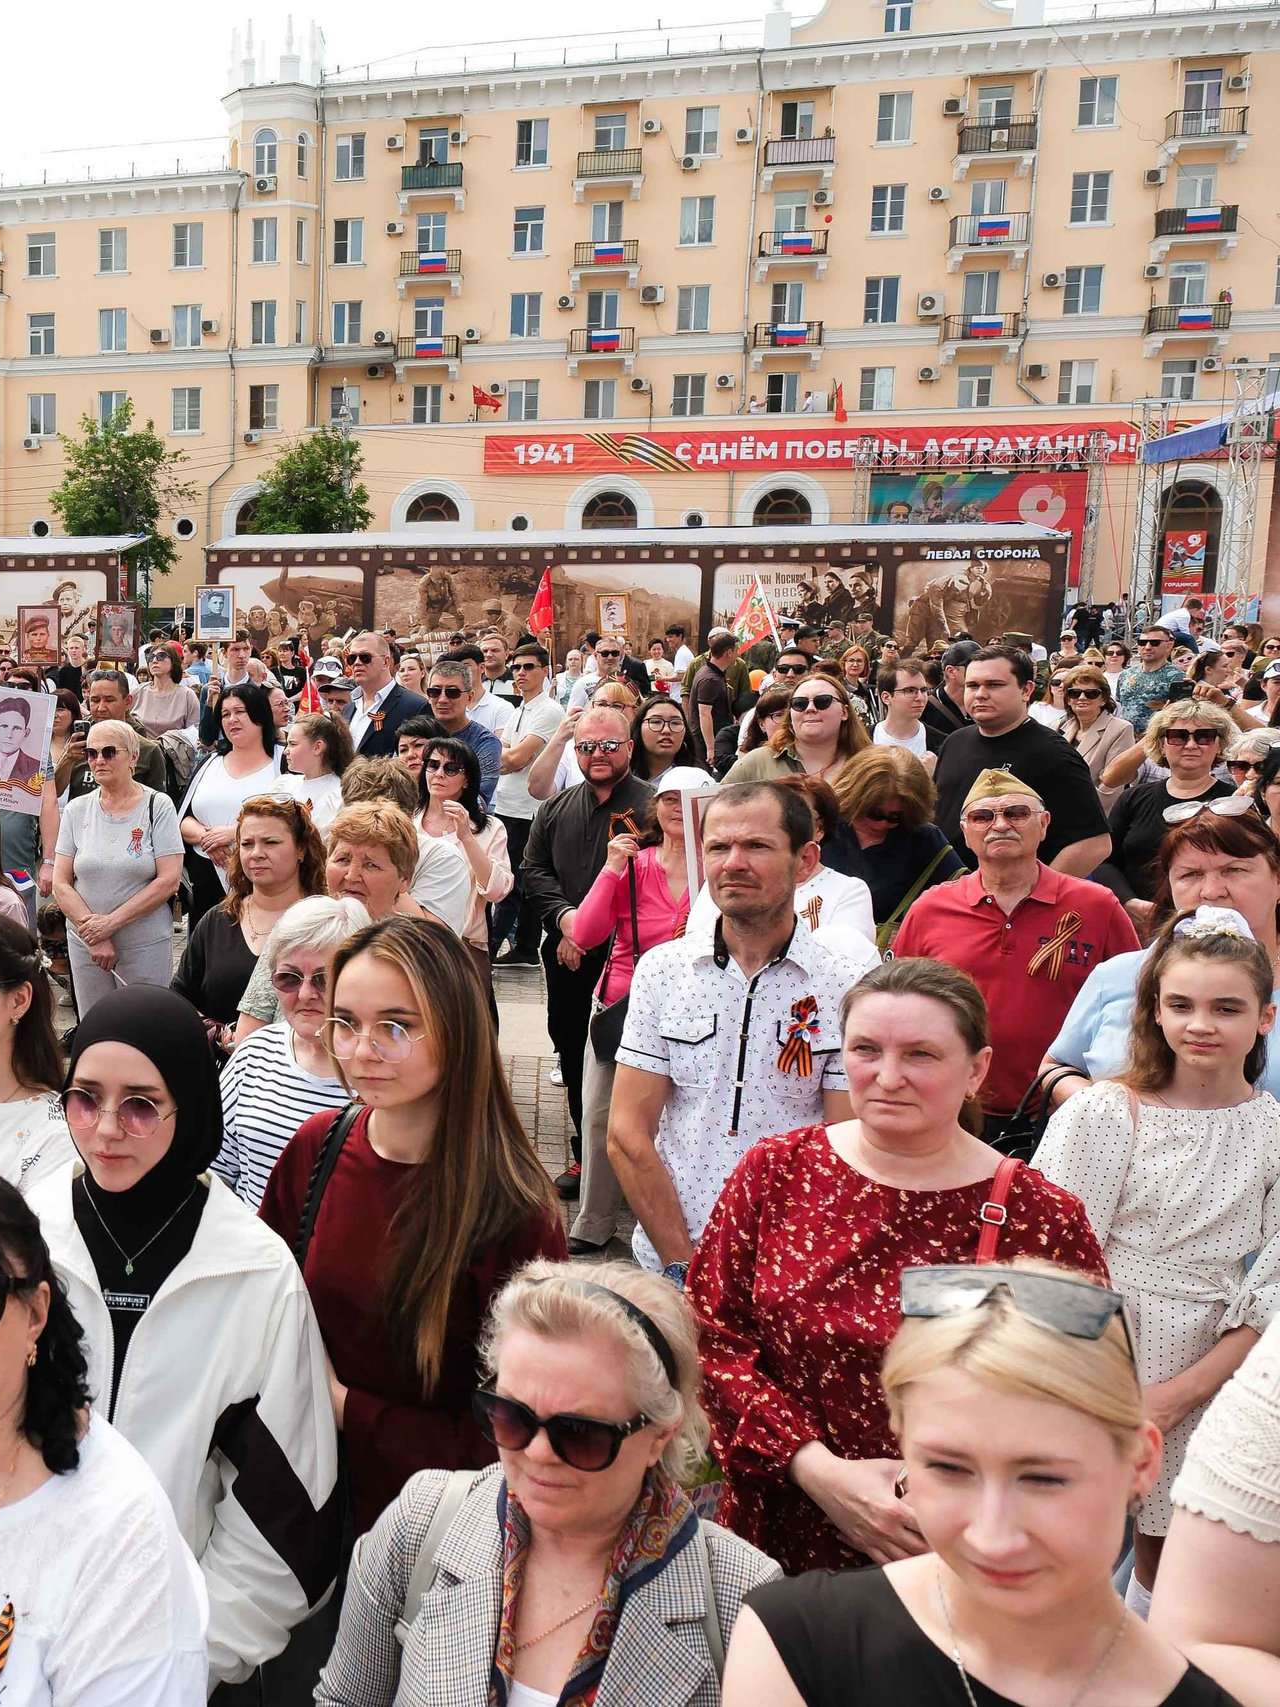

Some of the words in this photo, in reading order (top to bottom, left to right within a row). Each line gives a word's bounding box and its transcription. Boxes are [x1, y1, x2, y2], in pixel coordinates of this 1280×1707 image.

[513, 443, 575, 465] 1941
[675, 441, 692, 461] С
[696, 436, 778, 465] ДНЁМ
[925, 550, 971, 560] ЛЕВАЯ
[976, 549, 1041, 559] СТОРОНА
